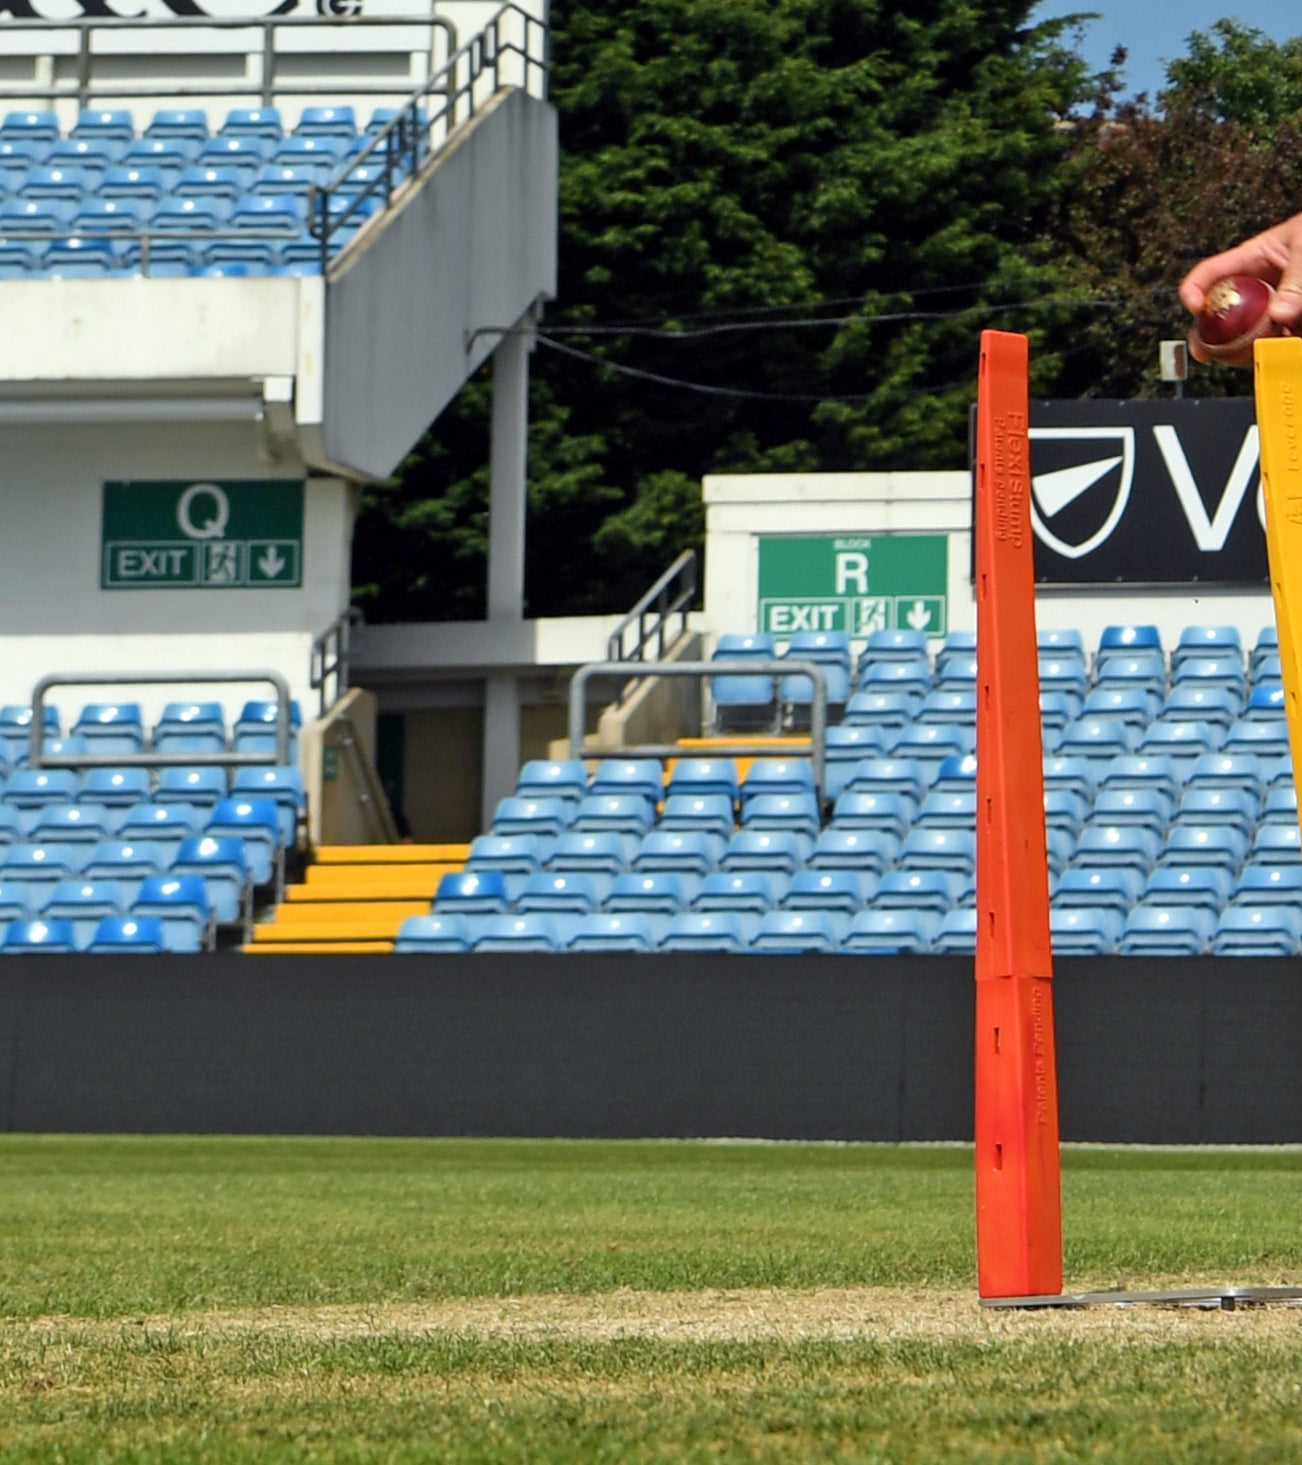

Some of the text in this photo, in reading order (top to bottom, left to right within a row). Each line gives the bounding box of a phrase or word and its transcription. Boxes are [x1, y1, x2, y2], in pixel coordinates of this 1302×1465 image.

[176, 482, 229, 539] Q
[118, 549, 188, 578] EXIT
[834, 552, 870, 595] R
[769, 605, 840, 633] EXIT
